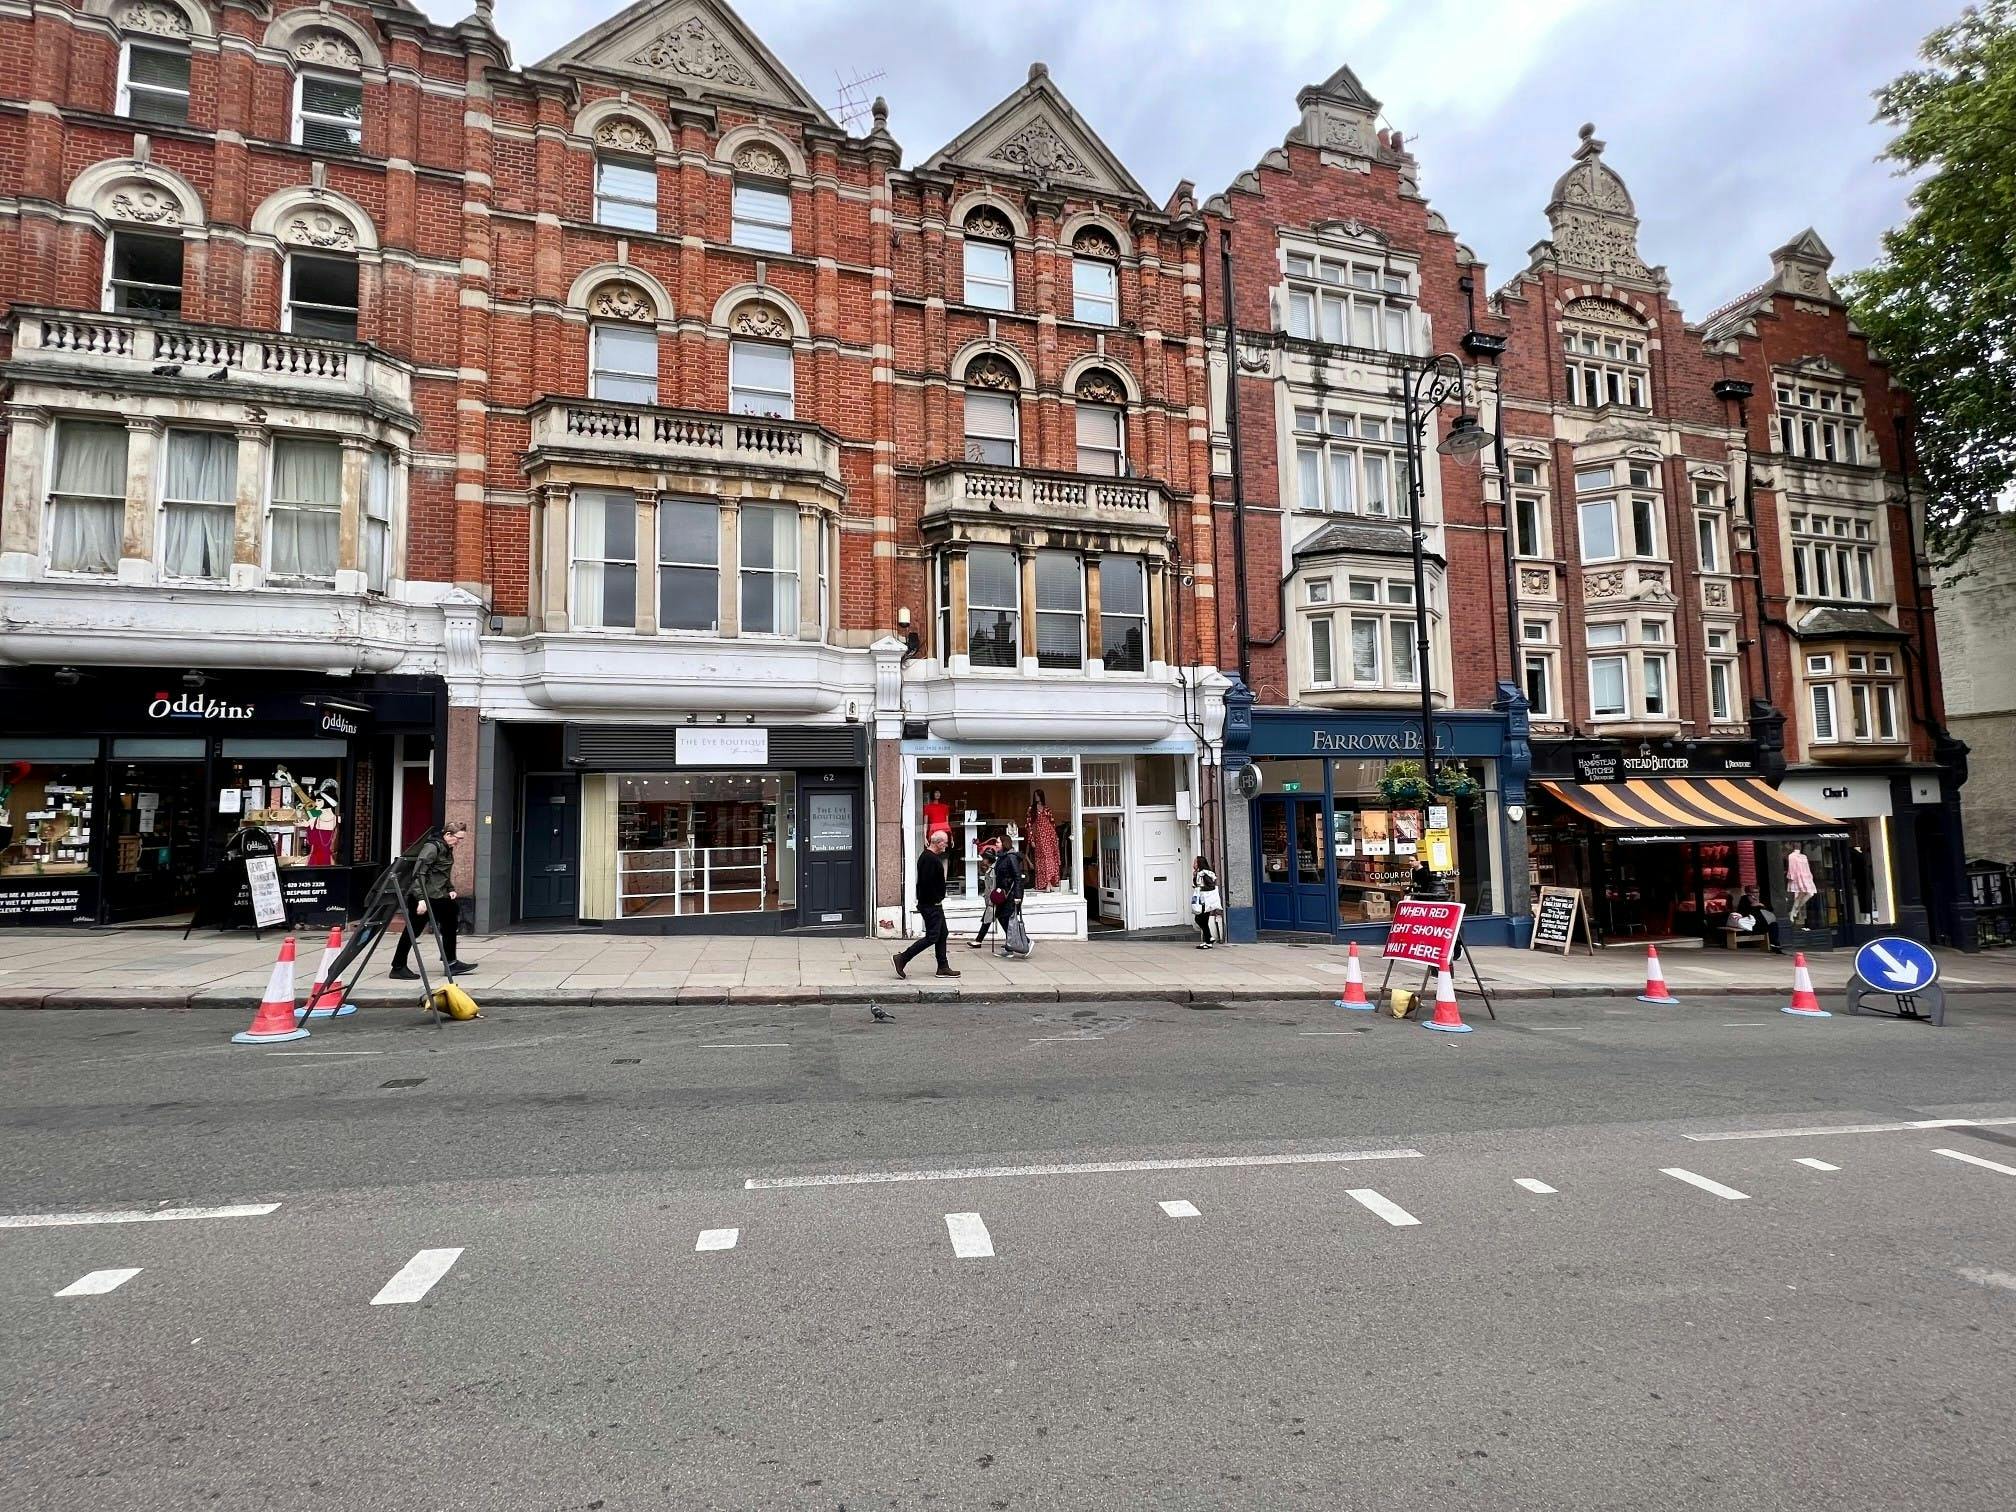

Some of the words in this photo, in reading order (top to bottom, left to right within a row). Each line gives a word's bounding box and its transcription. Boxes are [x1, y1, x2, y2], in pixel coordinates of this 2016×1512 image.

[148, 693, 254, 718] Oddbins
[322, 713, 357, 734] Oddbins
[681, 738, 698, 746] THE
[702, 738, 717, 746] EYE
[720, 738, 766, 747] BOUTIQUE
[1403, 730, 1445, 750] BAL
[1578, 758, 1617, 768] HAMPSTEAD
[1651, 755, 1689, 770] BUTCHER
[823, 773, 835, 781] 62
[1584, 766, 1614, 776] BUTCHER
[246, 840, 268, 851] Oddbins
[1369, 871, 1399, 880] COLOUR
[1400, 906, 1428, 918] WHEN
[1428, 907, 1449, 918] RED
[1411, 924, 1454, 939] SHOWS
[1386, 942, 1407, 953] WAIT
[1408, 943, 1441, 959] HERE
